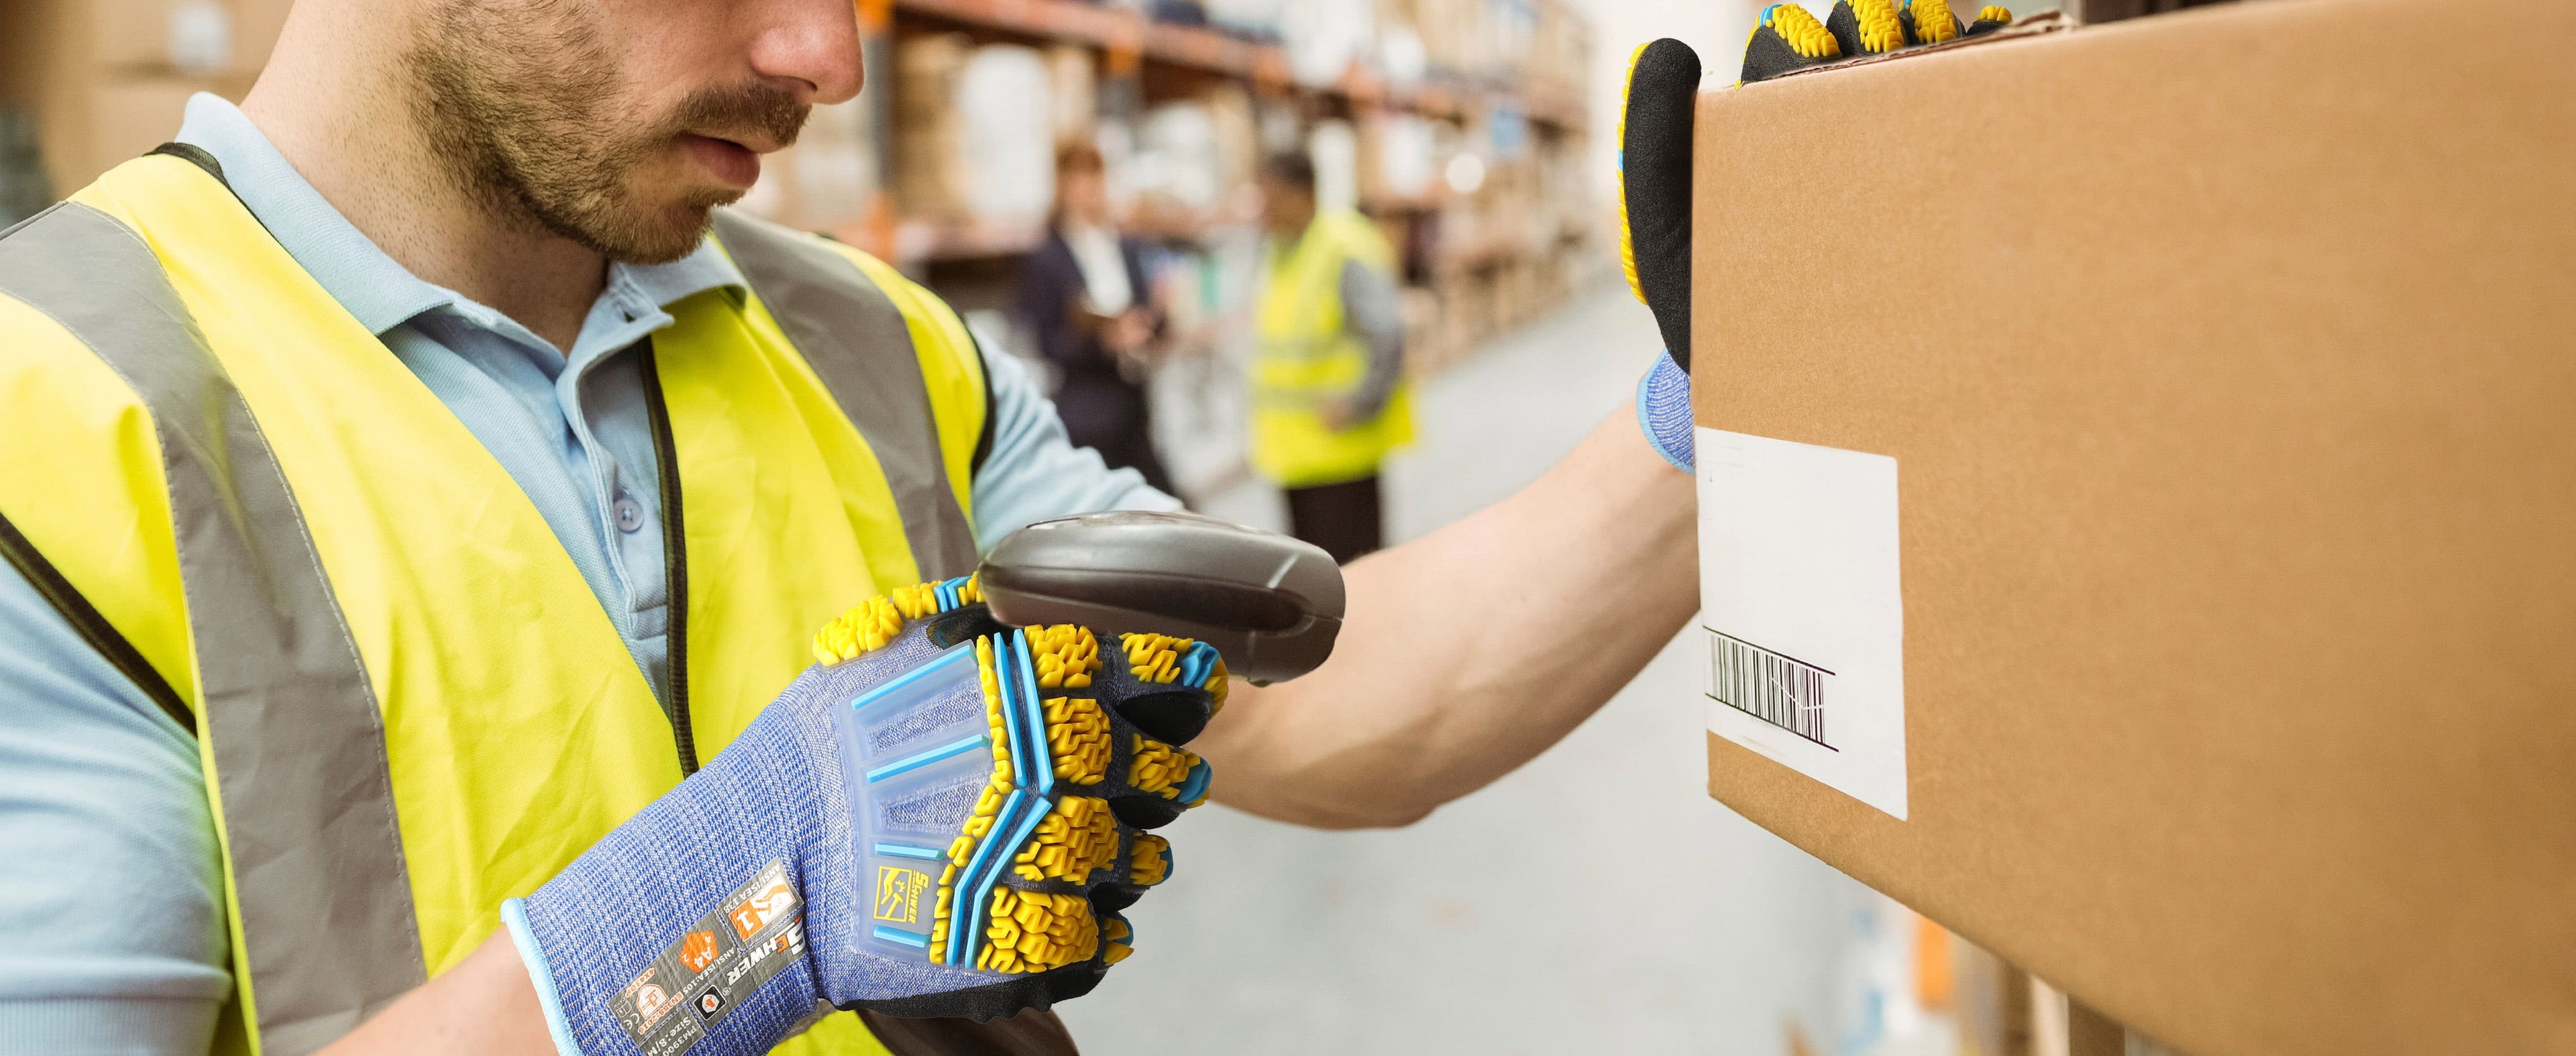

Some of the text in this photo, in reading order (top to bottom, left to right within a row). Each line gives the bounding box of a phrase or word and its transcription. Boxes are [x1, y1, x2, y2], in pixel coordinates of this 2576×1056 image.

[723, 863, 781, 914] ANSI/ISEA 138
[908, 871, 930, 924] SCHWER
[737, 912, 753, 931] 1
[694, 951, 712, 969] A4
[625, 967, 655, 998] 4X43DP
[638, 992, 684, 1035] EN388:2016
